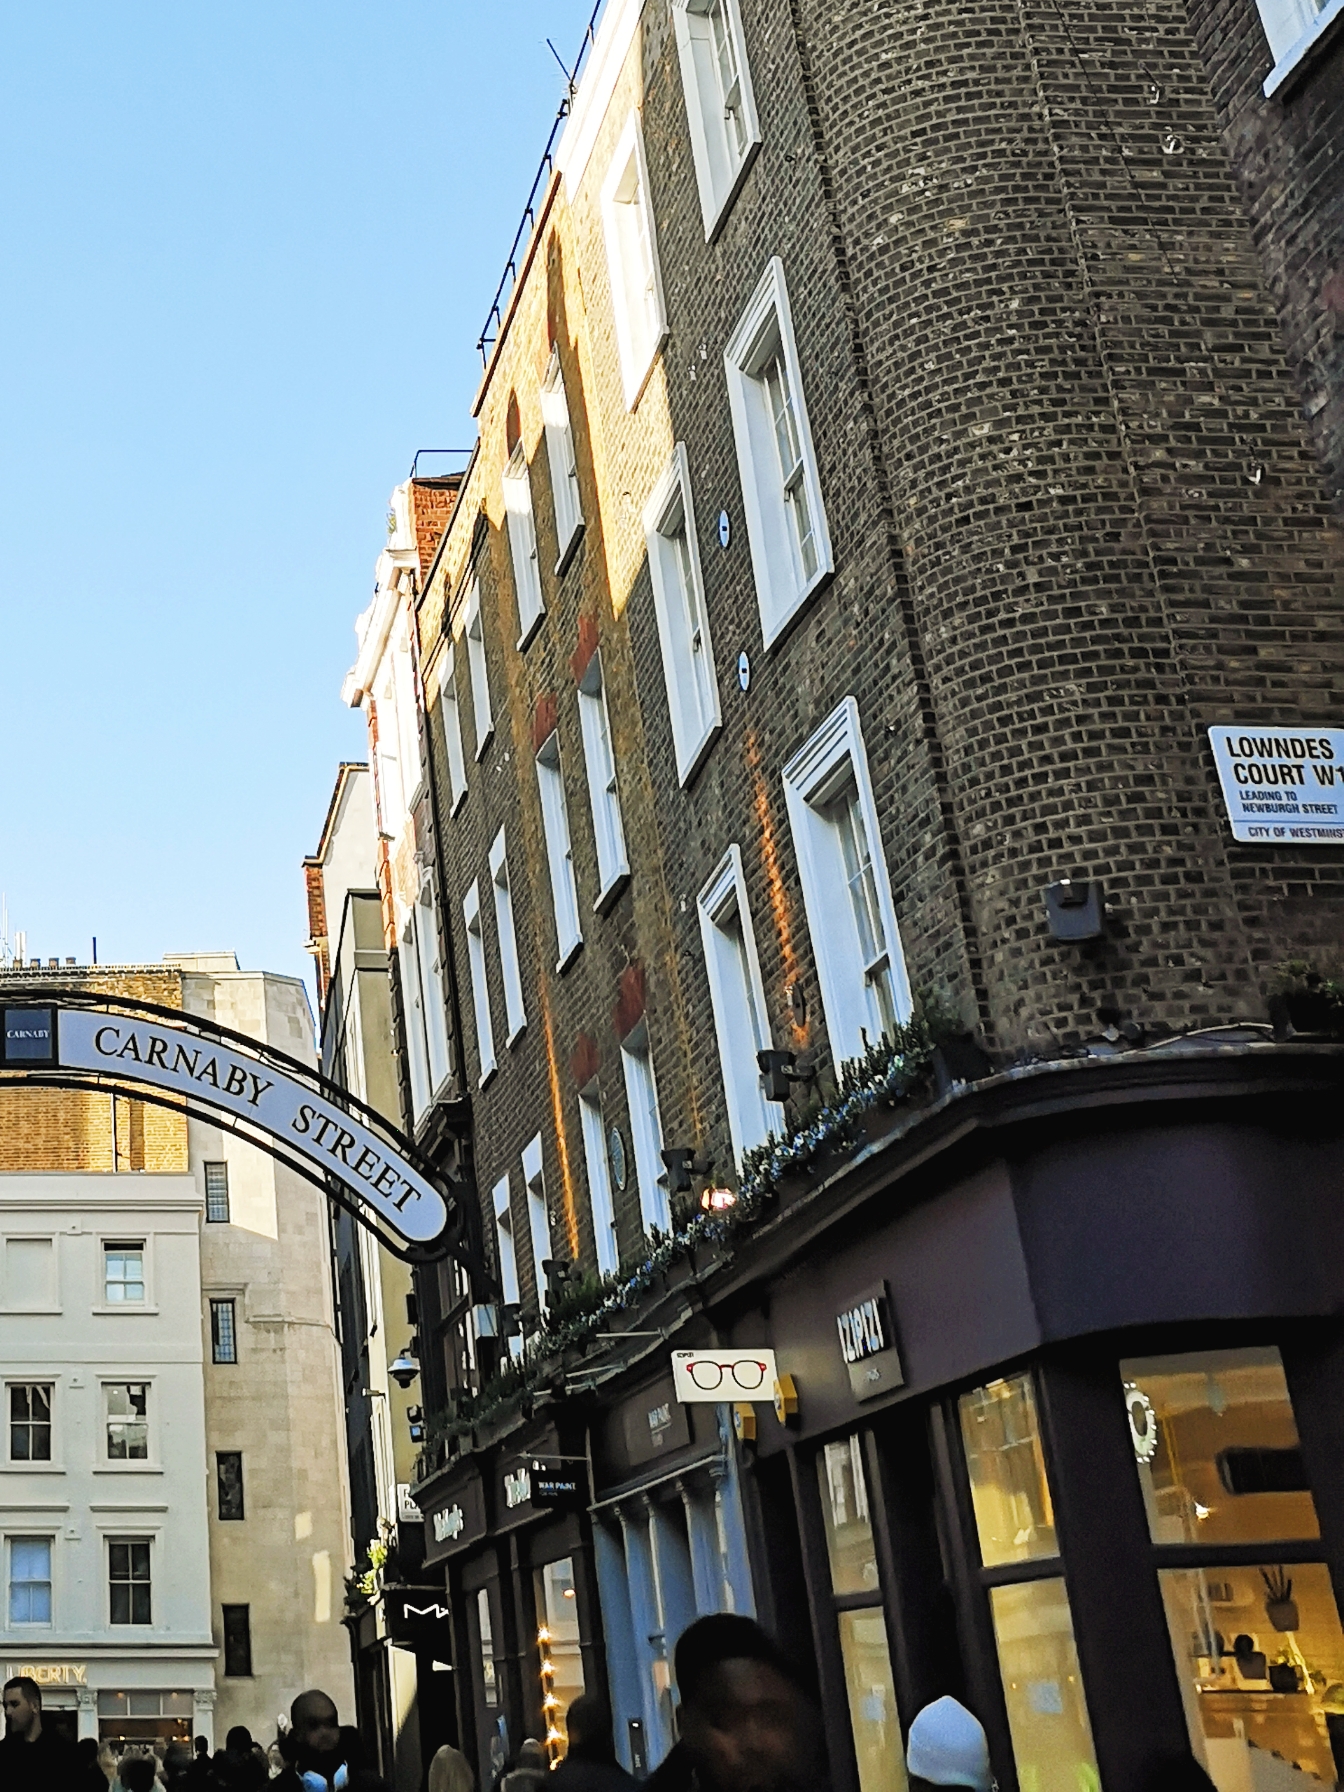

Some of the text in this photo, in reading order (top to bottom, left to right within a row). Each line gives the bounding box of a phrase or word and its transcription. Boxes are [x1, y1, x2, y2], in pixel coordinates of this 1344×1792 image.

[1226, 736, 1334, 759] LOWNDES
[1233, 763, 1305, 785] COURT
[1239, 790, 1297, 801] LEADING TO
[1242, 802, 1338, 815] NEWBURGH STREET
[1248, 827, 1270, 837] CITY
[1273, 827, 1286, 837] OF
[6, 1029, 49, 1039] CARNABY
[94, 1026, 275, 1107] CARNABY
[292, 1104, 422, 1214] STREET
[538, 1481, 576, 1490] WAR PAINT
